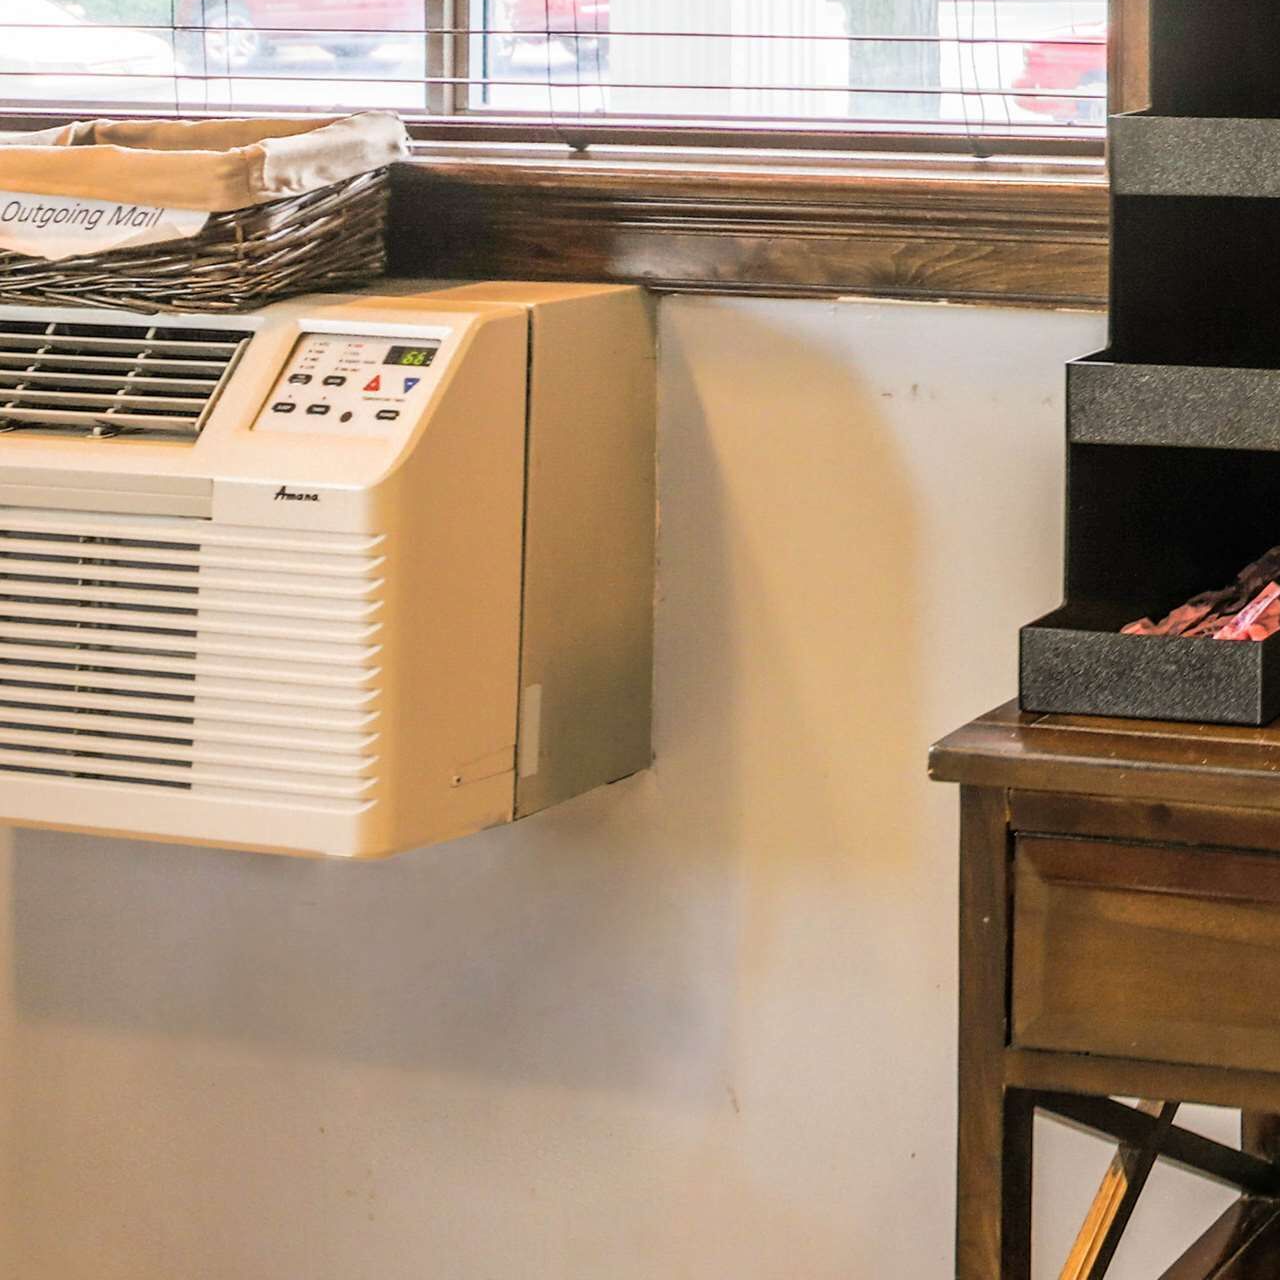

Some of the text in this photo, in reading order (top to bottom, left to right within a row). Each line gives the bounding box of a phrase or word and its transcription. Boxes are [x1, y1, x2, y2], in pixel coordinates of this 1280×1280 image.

[1, 201, 166, 231] Outgoing Mail
[274, 485, 320, 502] Amana
